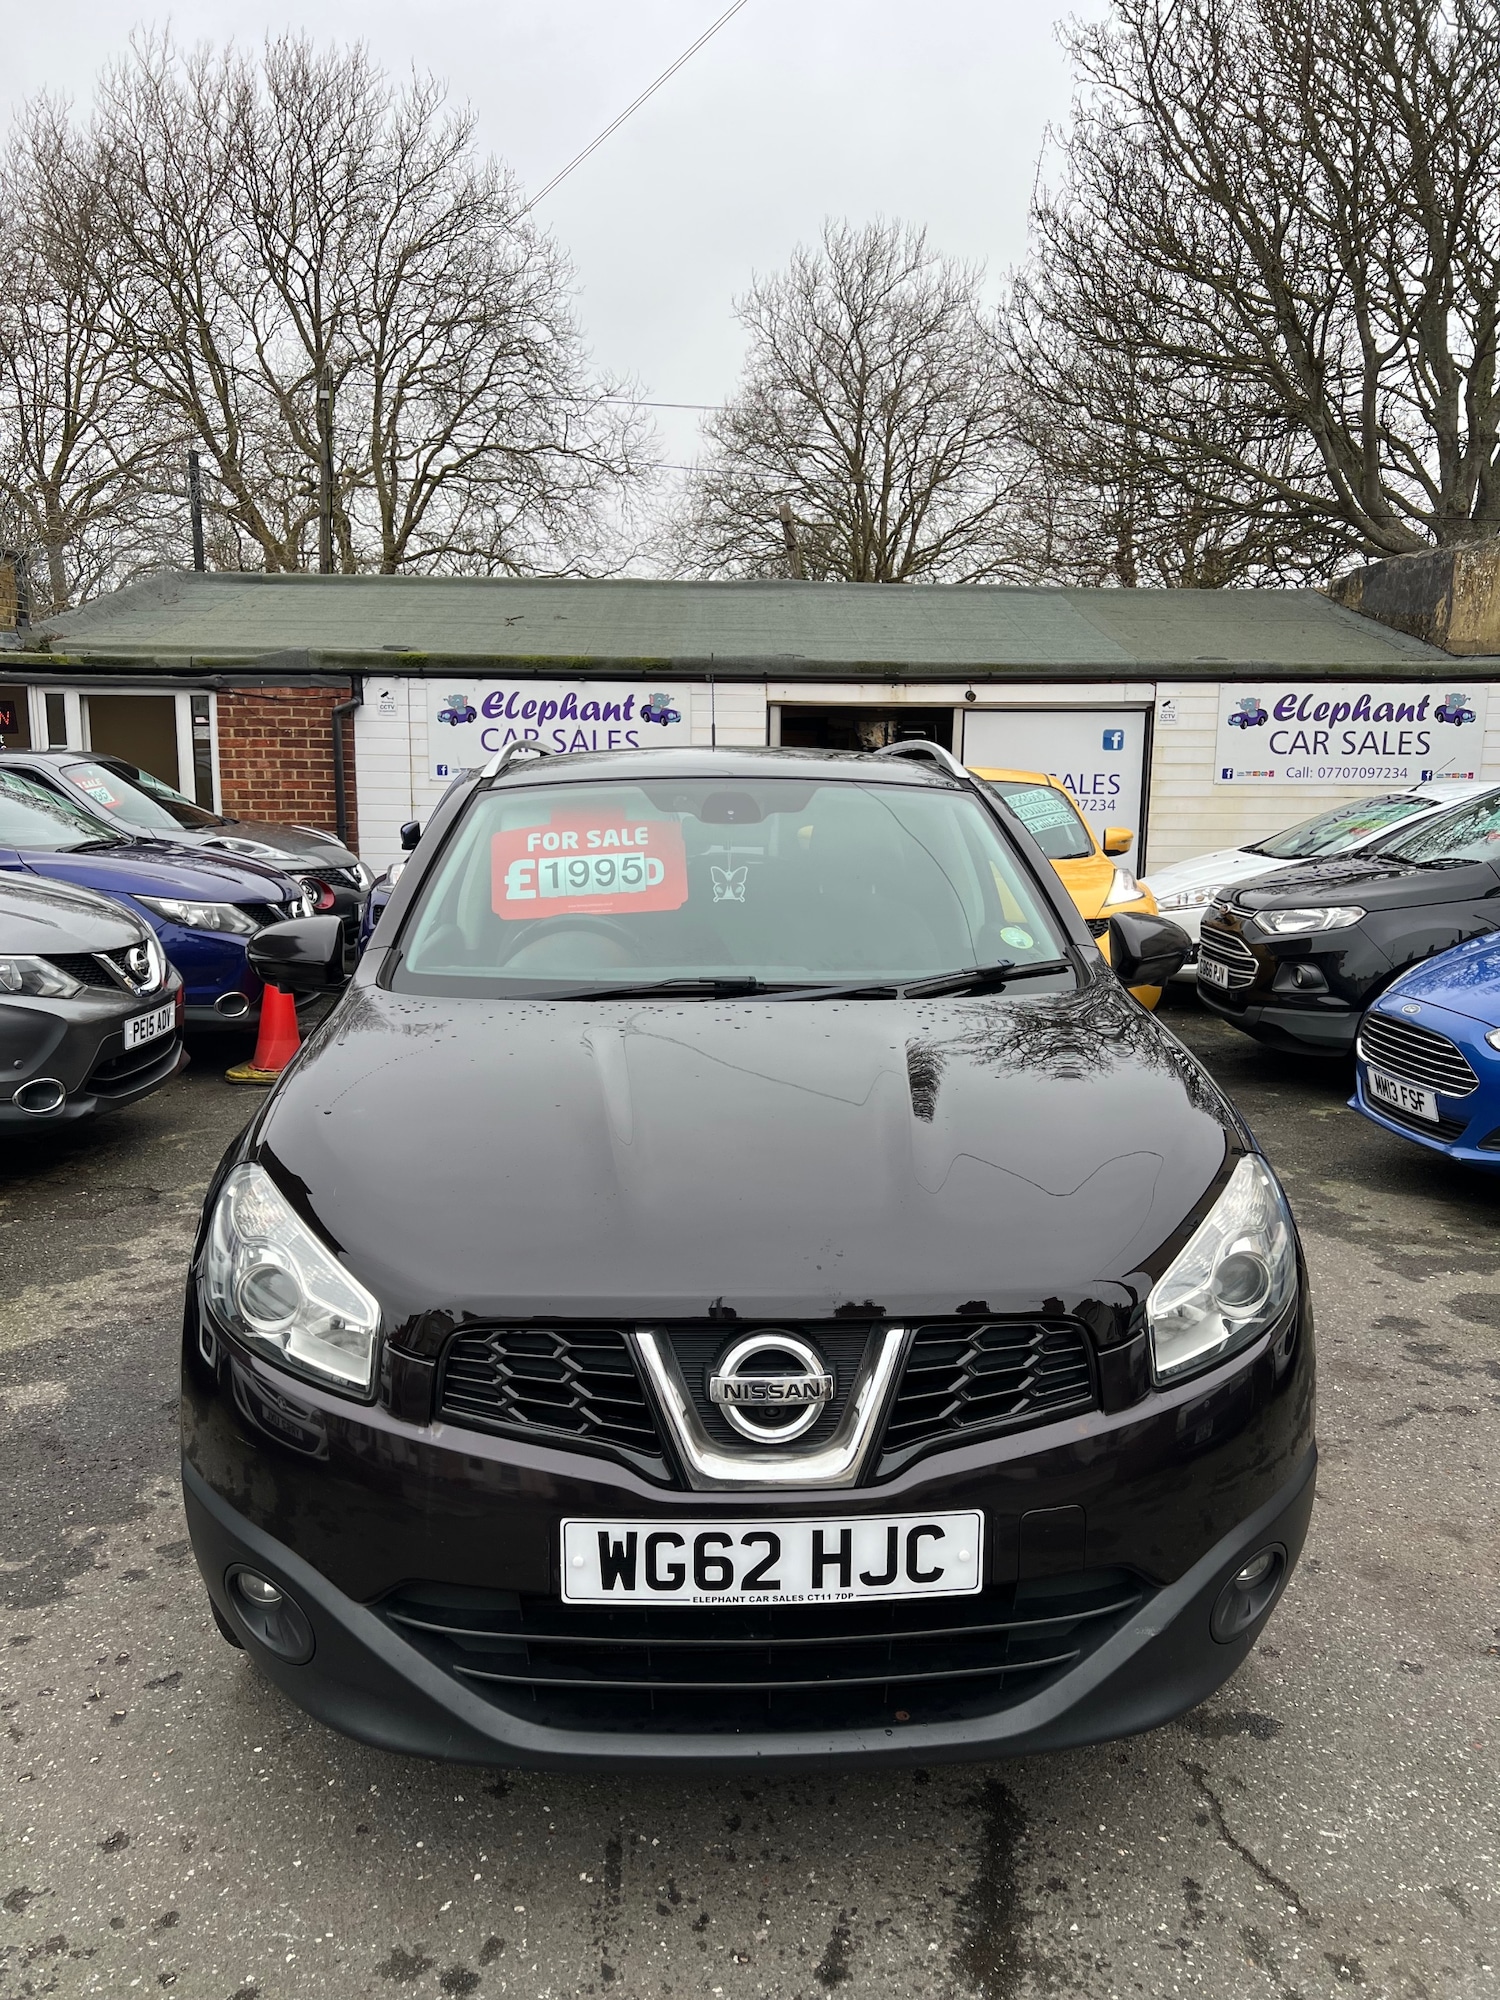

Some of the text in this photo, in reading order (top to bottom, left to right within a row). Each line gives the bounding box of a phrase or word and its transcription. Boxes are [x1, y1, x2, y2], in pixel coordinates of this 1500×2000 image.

[481, 690, 635, 727] Elephant
[1272, 692, 1430, 729] Elephant
[1268, 730, 1431, 756] CAR SALES
[1048, 773, 1121, 795] ALES
[1285, 766, 1313, 779] Call:
[1317, 766, 1409, 779] 07707097234
[527, 826, 649, 852] FOR SALE
[133, 1014, 155, 1043] PE15
[1400, 1085, 1425, 1112] FSF
[723, 1381, 823, 1400] NISSAN
[597, 1523, 947, 1592] WG62 HJC
[772, 1594, 805, 1602] SALES
[807, 1593, 832, 1601] CT11
[835, 1592, 855, 1600] 7DP
